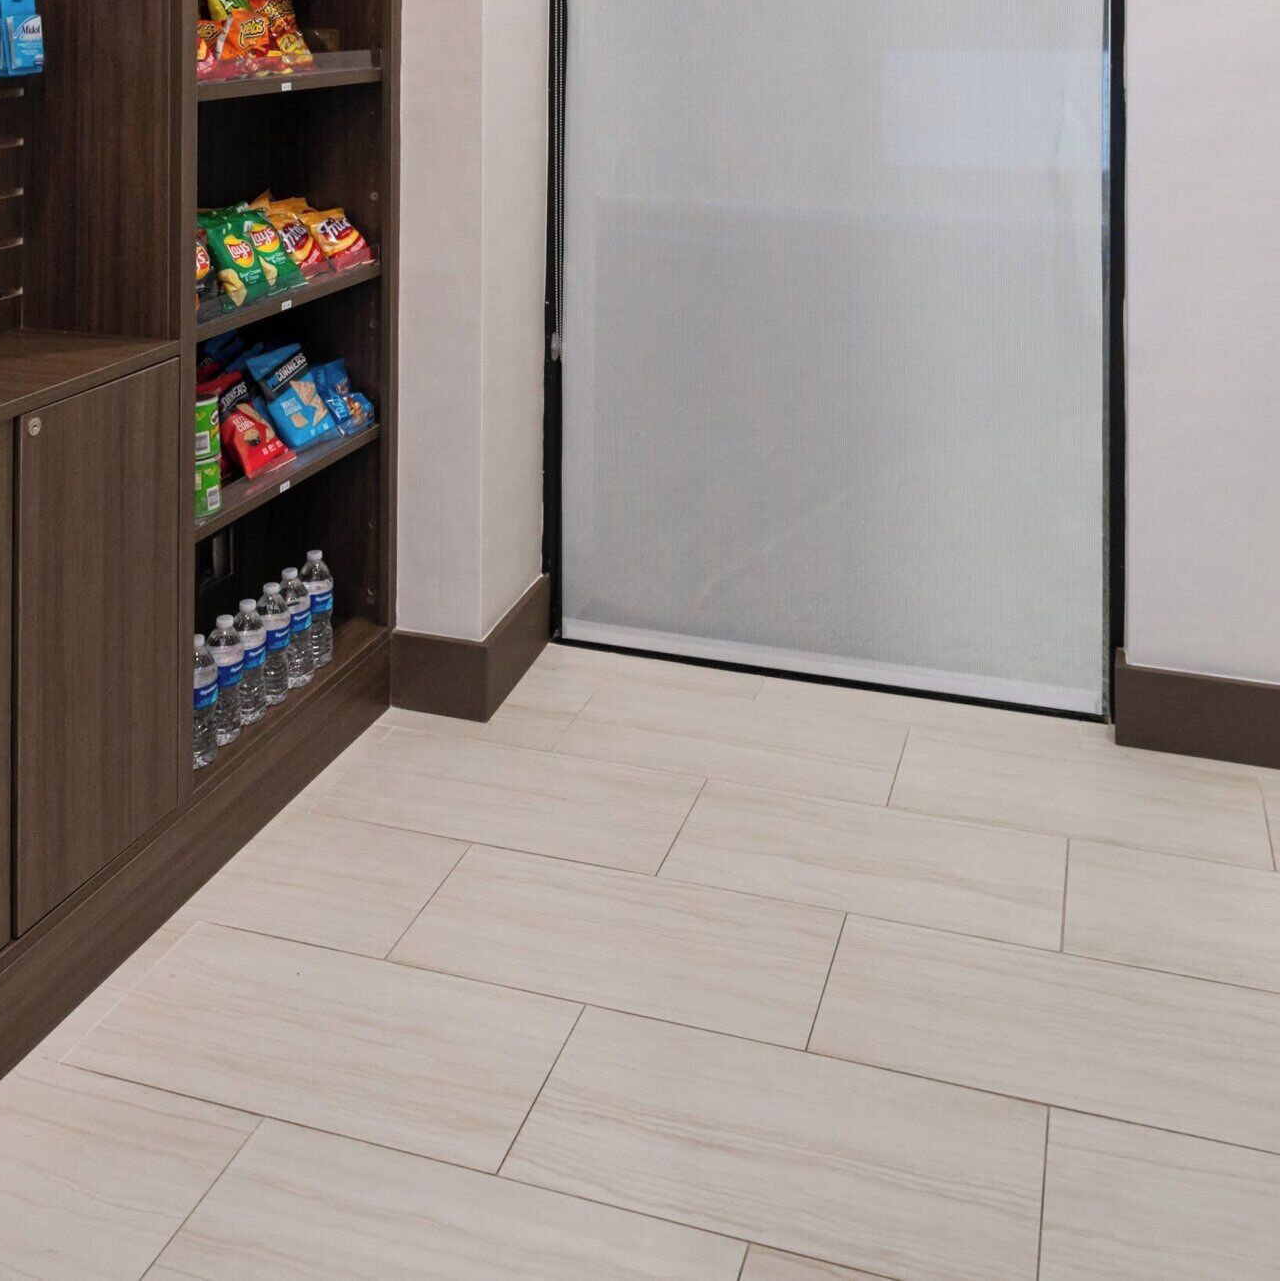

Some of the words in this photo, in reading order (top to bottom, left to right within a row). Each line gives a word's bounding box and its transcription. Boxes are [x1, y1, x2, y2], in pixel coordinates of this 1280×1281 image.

[21, 24, 41, 35] Midol
[250, 227, 276, 247] Lay's
[227, 241, 251, 259] Lay's
